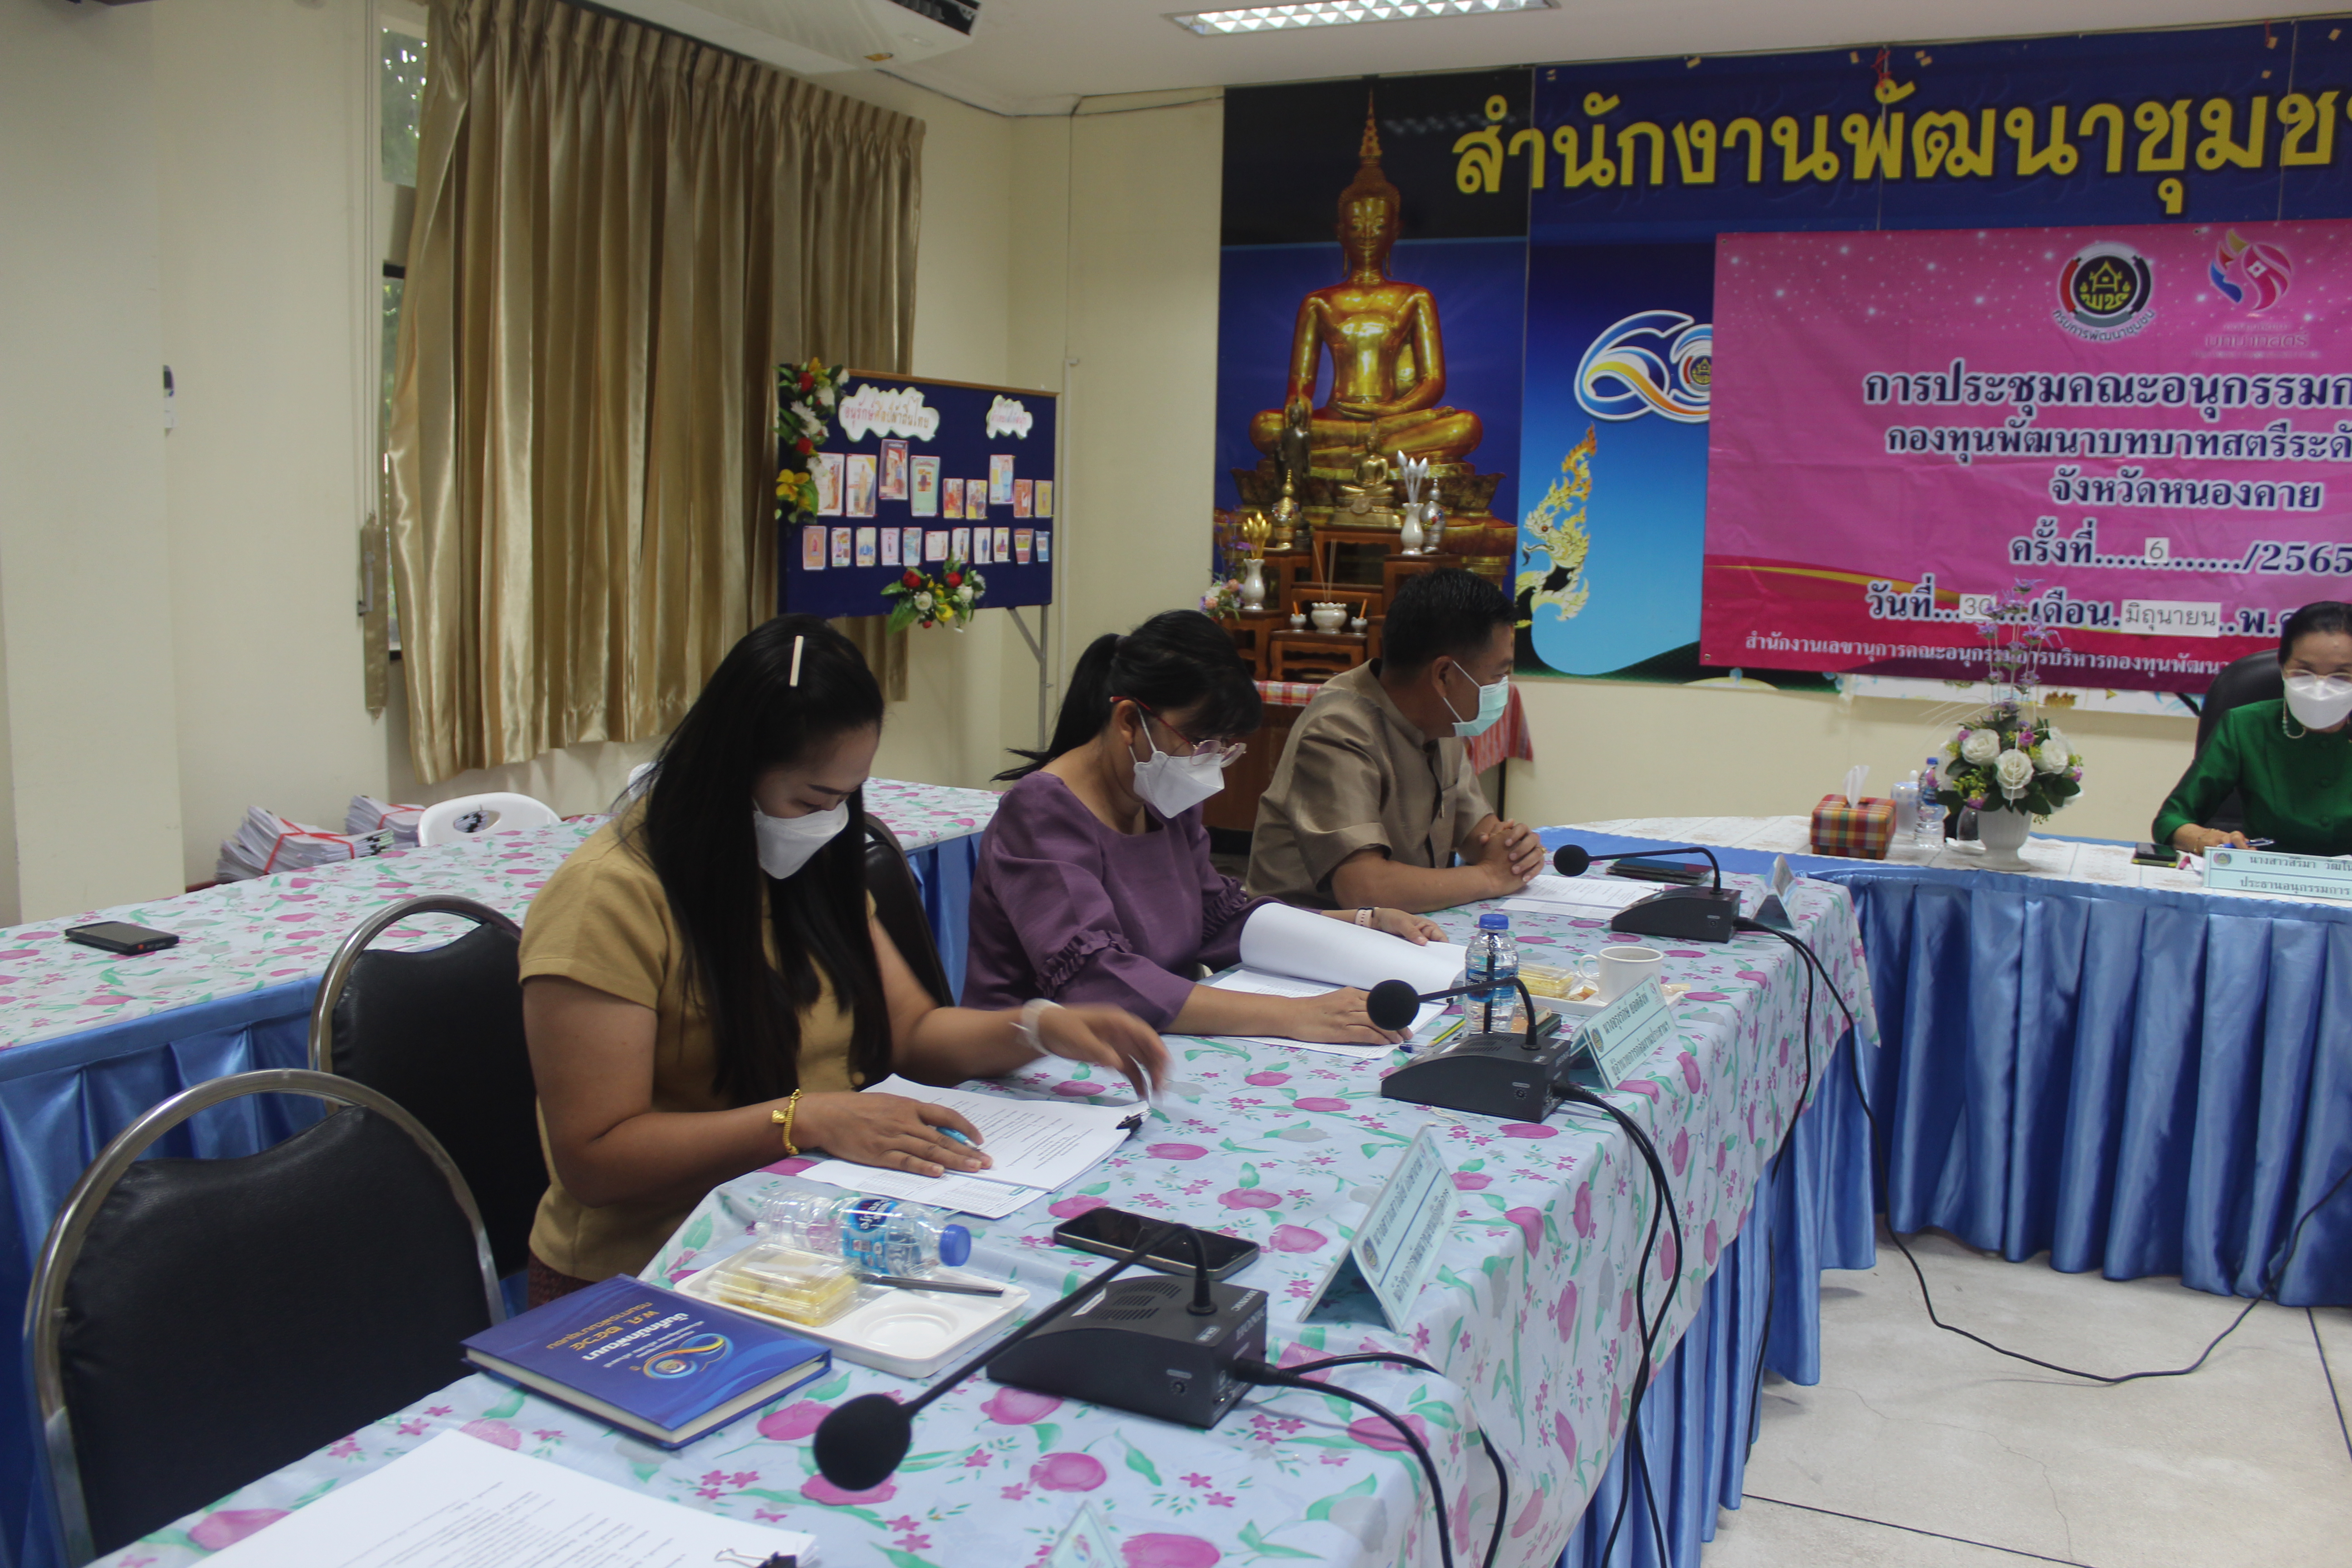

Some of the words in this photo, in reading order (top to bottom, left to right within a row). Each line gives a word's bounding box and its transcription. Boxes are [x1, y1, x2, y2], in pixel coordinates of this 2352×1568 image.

[1452, 78, 2352, 214] สำนักงานพัฒนาชุมช
[1865, 360, 2352, 419] การประชุมคณะอนุกรรมก
[2051, 468, 2322, 510] จังหวัดหนองคาย
[2125, 603, 2216, 630] มิถุนายน
[2240, 876, 2350, 895] ประธานอนุกรรมการ
